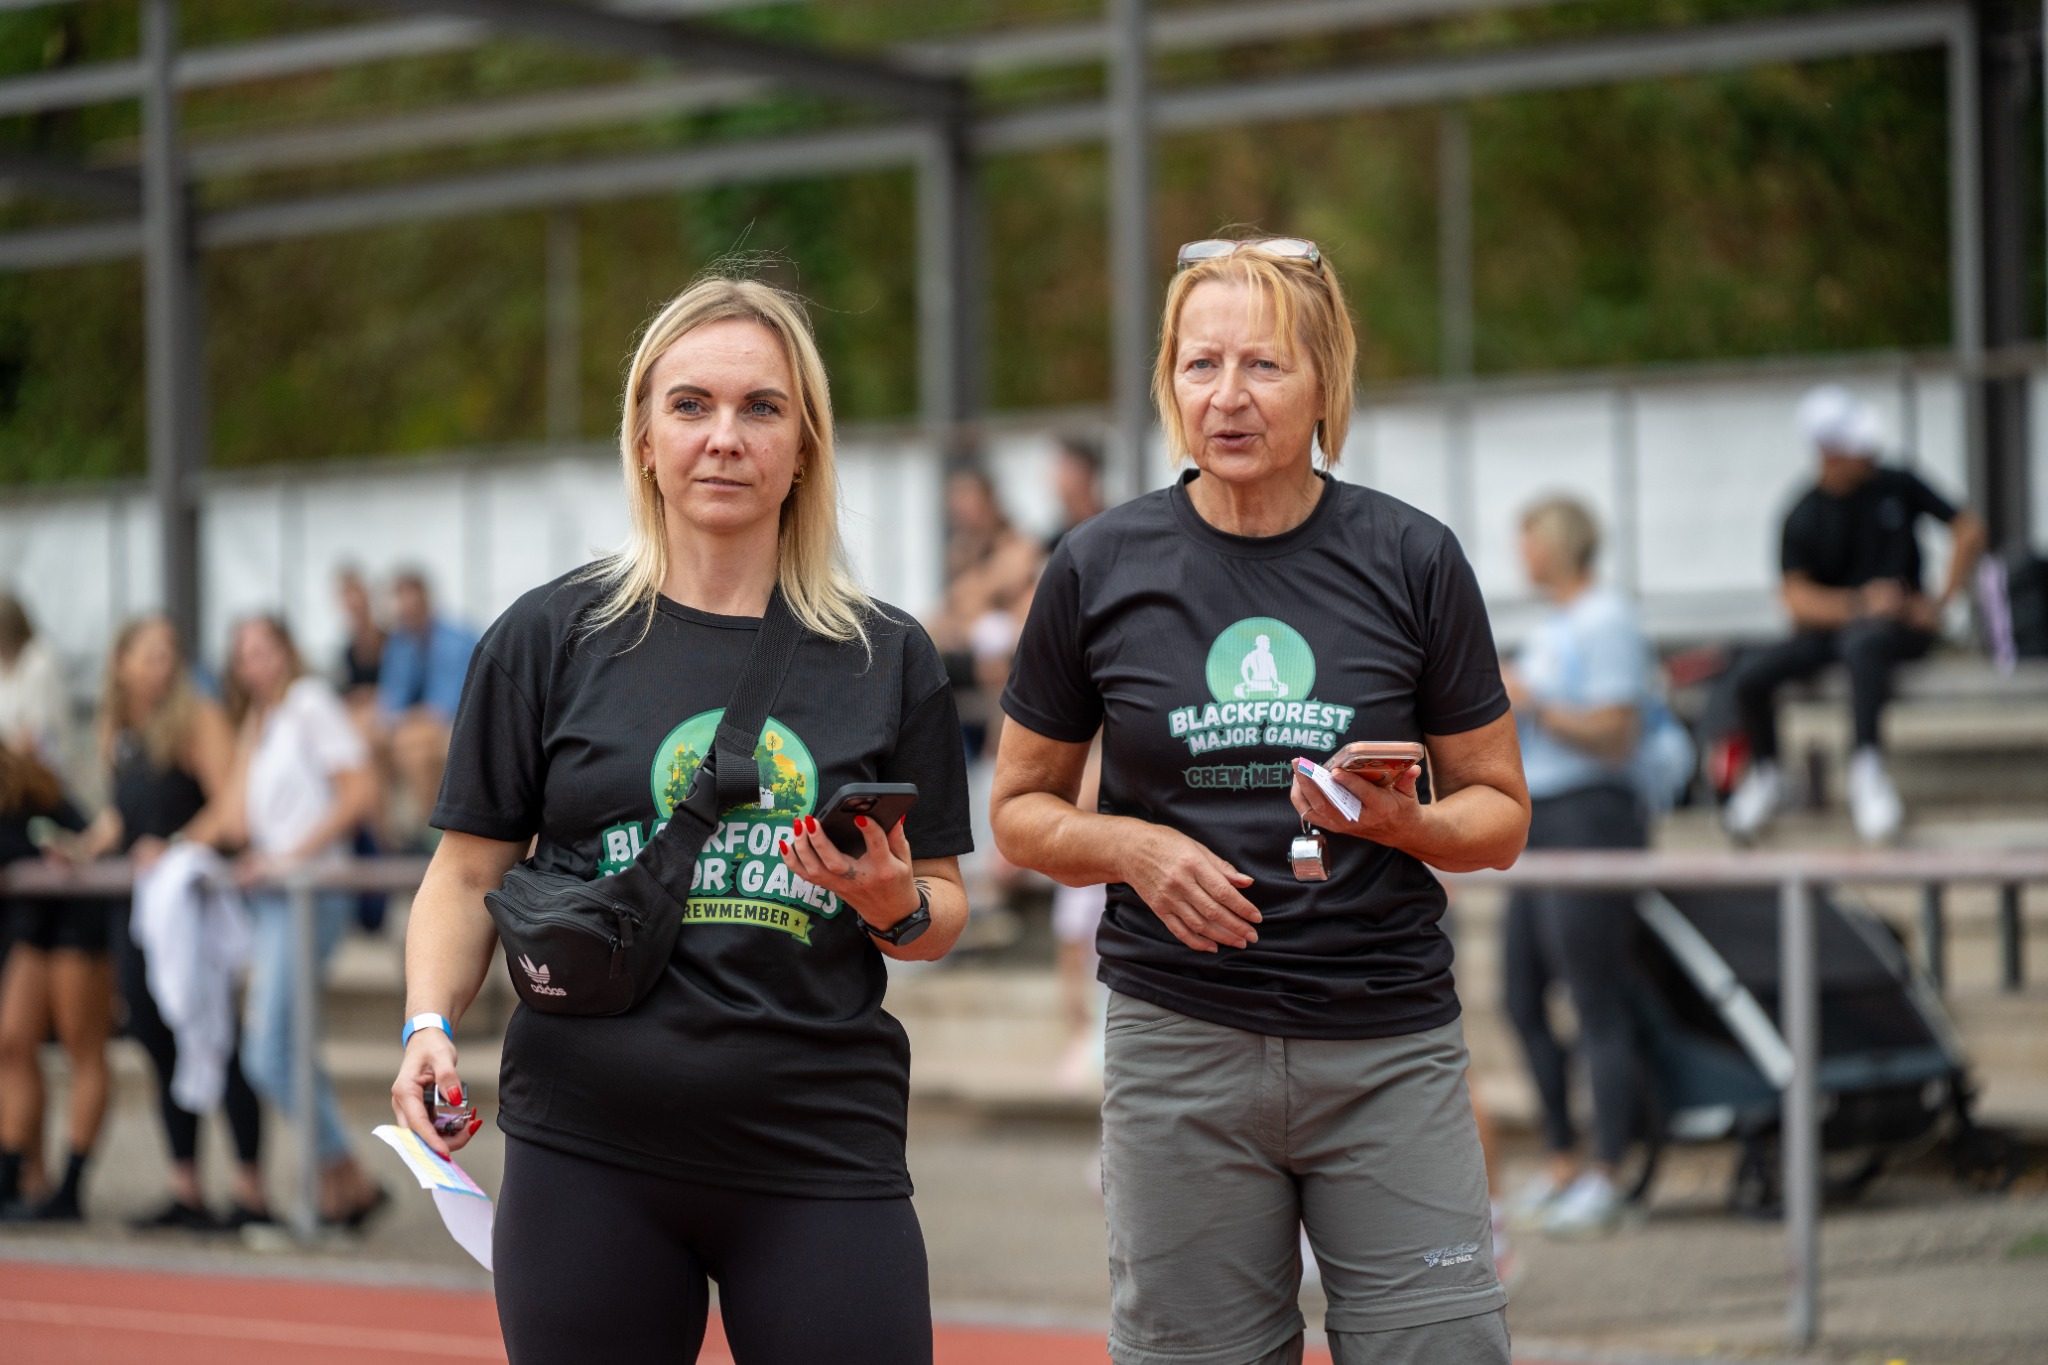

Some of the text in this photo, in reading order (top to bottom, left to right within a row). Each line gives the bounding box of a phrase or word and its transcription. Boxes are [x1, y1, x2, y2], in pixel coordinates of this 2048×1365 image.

[1171, 701, 1352, 735] BLACKFOREST
[1189, 726, 1335, 753] MAJOR GAMES
[1188, 767, 1294, 786] CREW MEM
[683, 902, 790, 927] REWMEMBER
[530, 983, 567, 996] adidas
